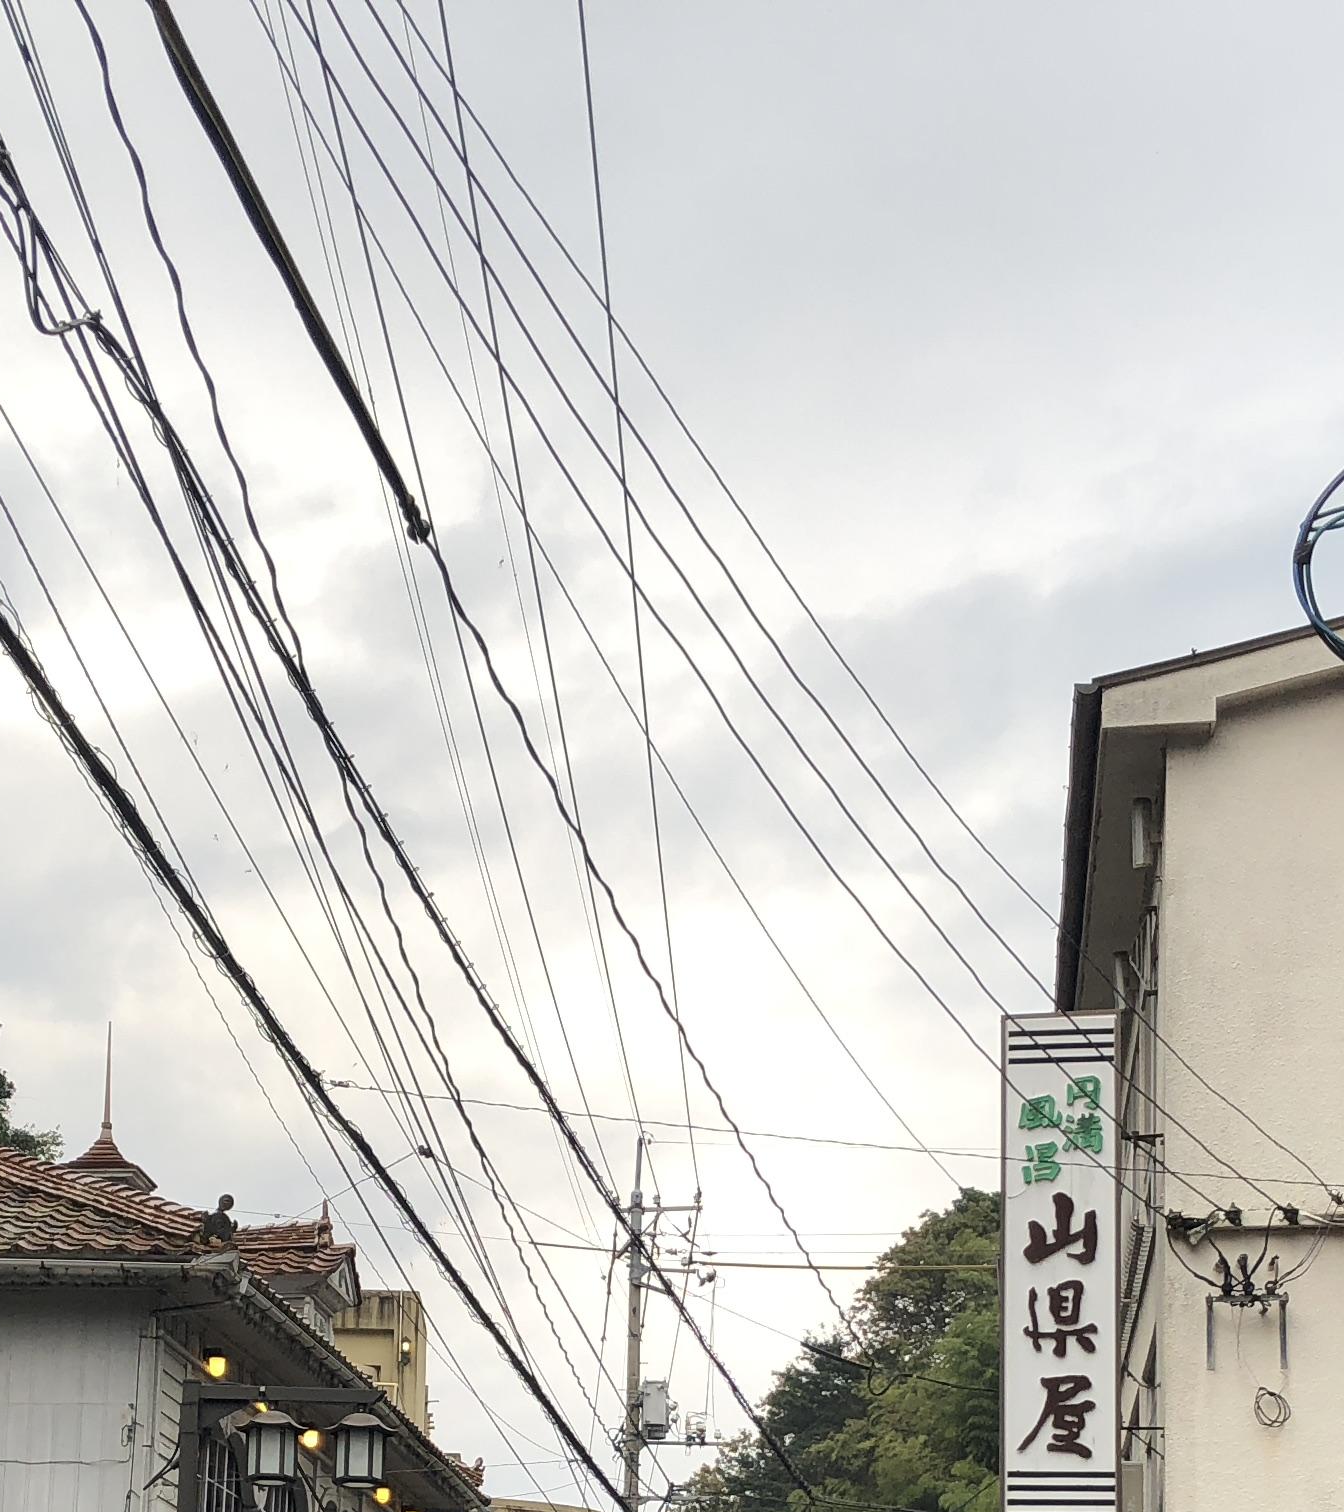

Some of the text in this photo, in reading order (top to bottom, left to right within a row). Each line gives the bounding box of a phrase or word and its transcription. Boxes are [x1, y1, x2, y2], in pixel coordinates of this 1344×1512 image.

[1062, 1075, 1104, 1154] 円満
[1016, 1192, 1099, 1460] 山県屋
